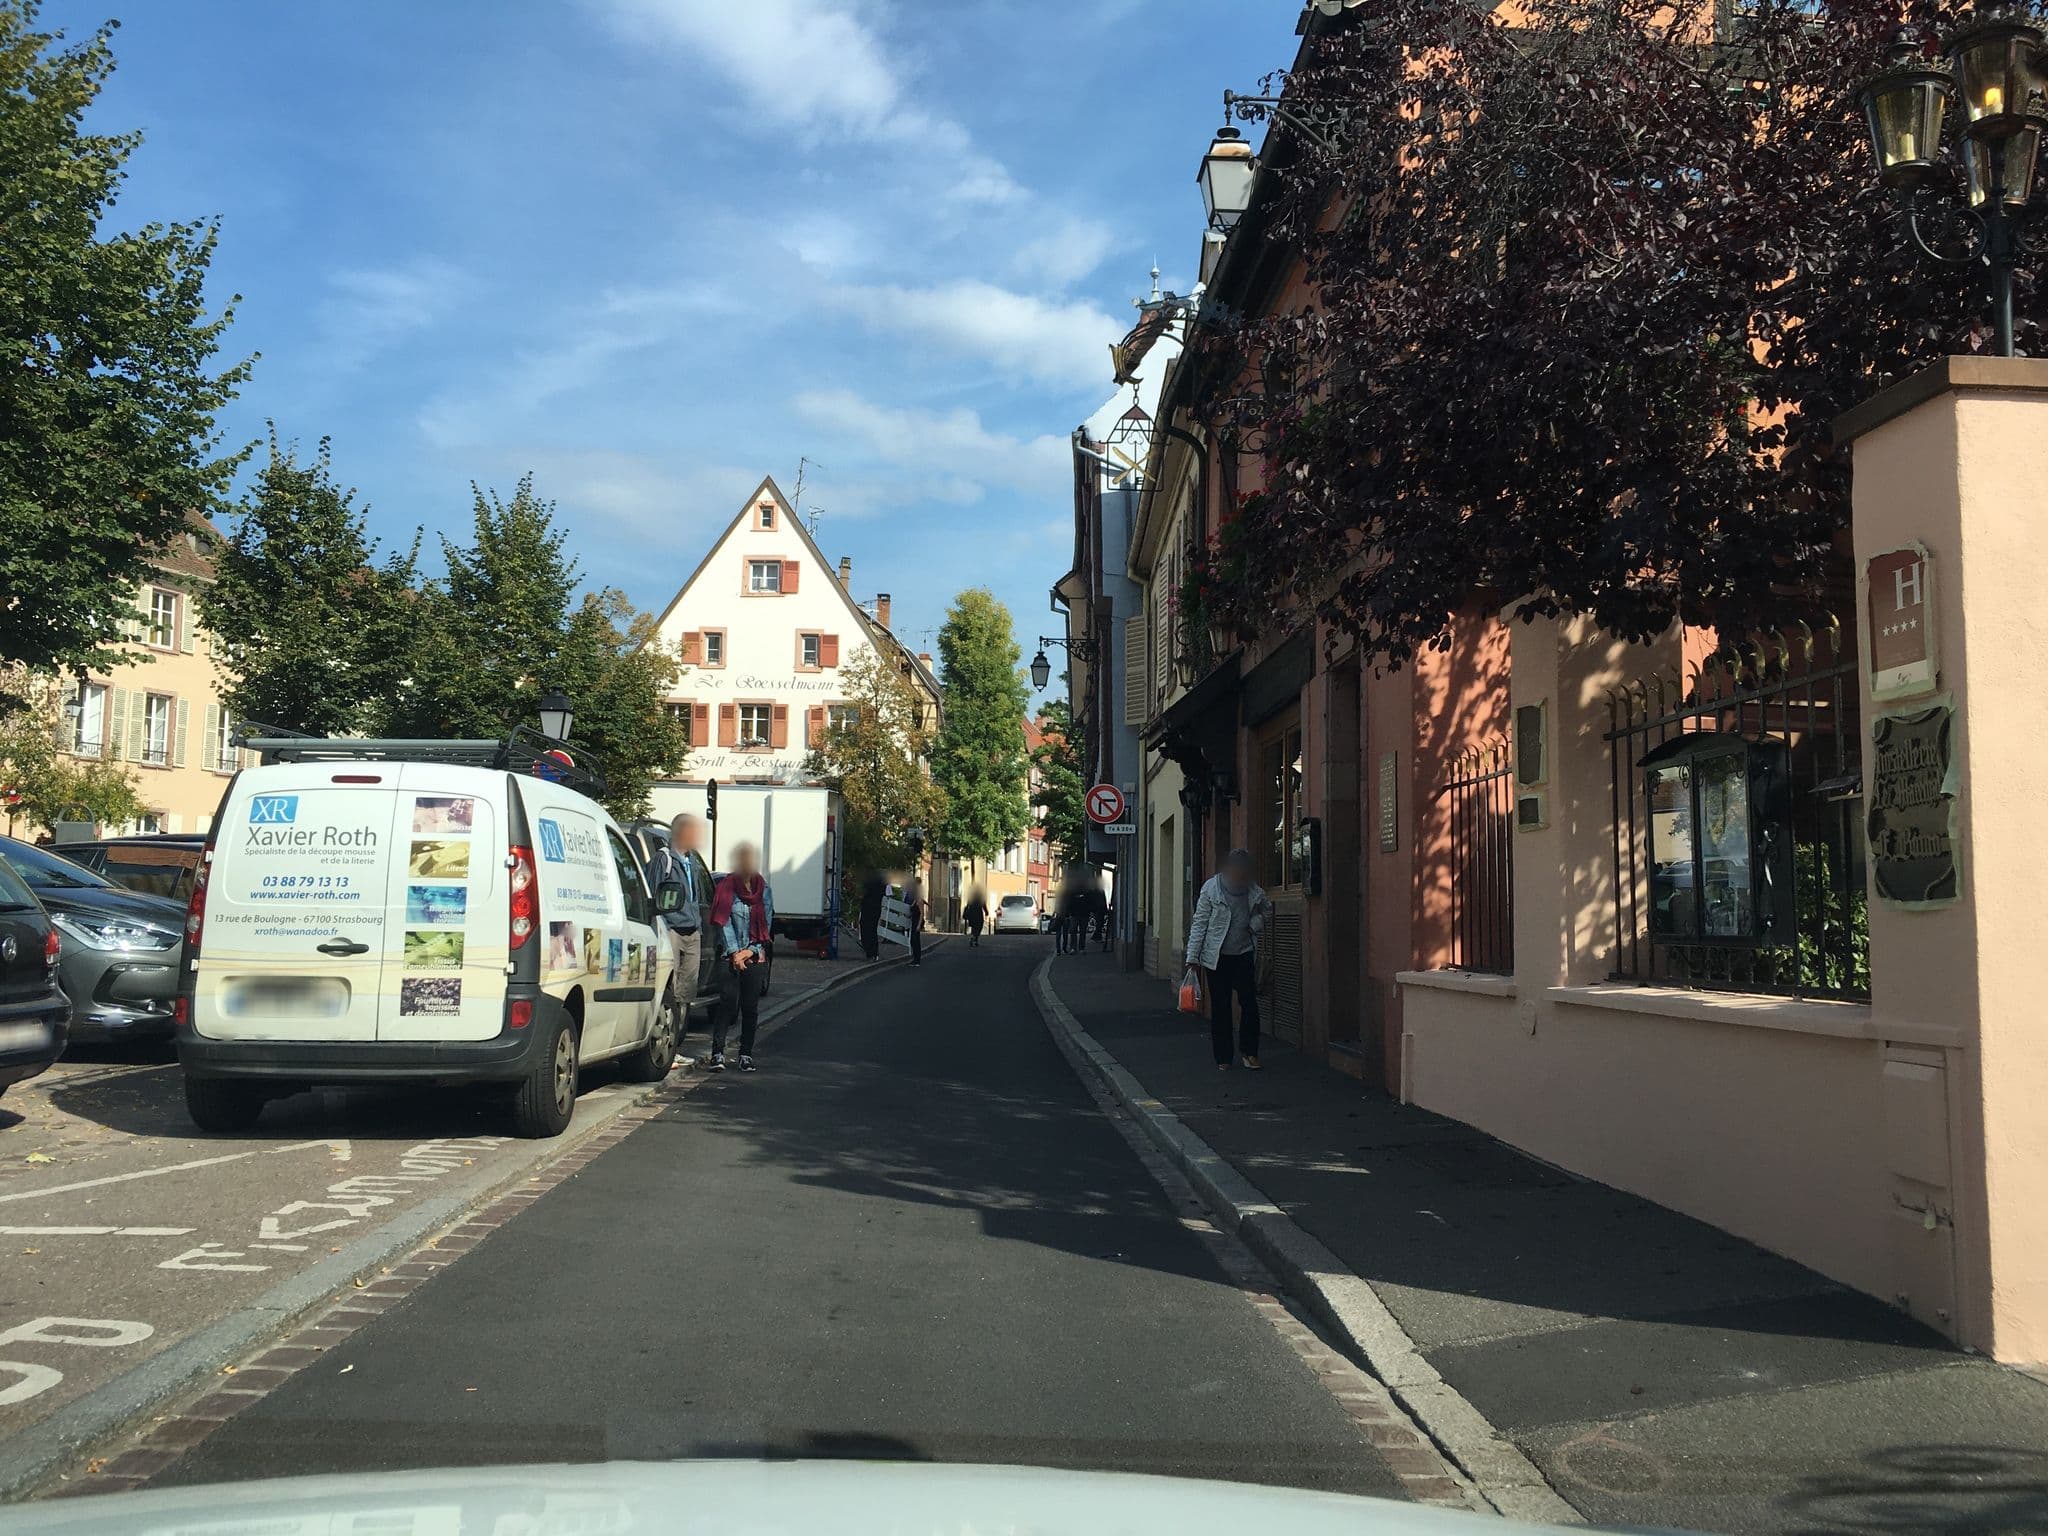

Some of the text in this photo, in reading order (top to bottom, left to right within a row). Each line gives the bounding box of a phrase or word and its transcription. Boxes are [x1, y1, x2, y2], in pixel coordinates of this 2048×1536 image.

[1892, 562, 1924, 612] H
[694, 674, 834, 690] Le Roesselmann
[688, 755, 725, 770] Grill
[251, 798, 293, 822] XR
[245, 826, 377, 846] Xavier Roth
[539, 822, 564, 858] XR
[244, 848, 286, 856] Spécialiste
[307, 848, 343, 856] découpe
[262, 876, 349, 887] 03 88 79 13 13
[250, 890, 360, 900] www.xavier-roth.com
[214, 914, 224, 923] 13
[241, 915, 252, 923] de
[253, 915, 296, 925] Boulogne
[303, 915, 331, 923] 67100
[332, 915, 383, 925] Strasbourg
[254, 927, 339, 936] xroth@wanadoo.fr
